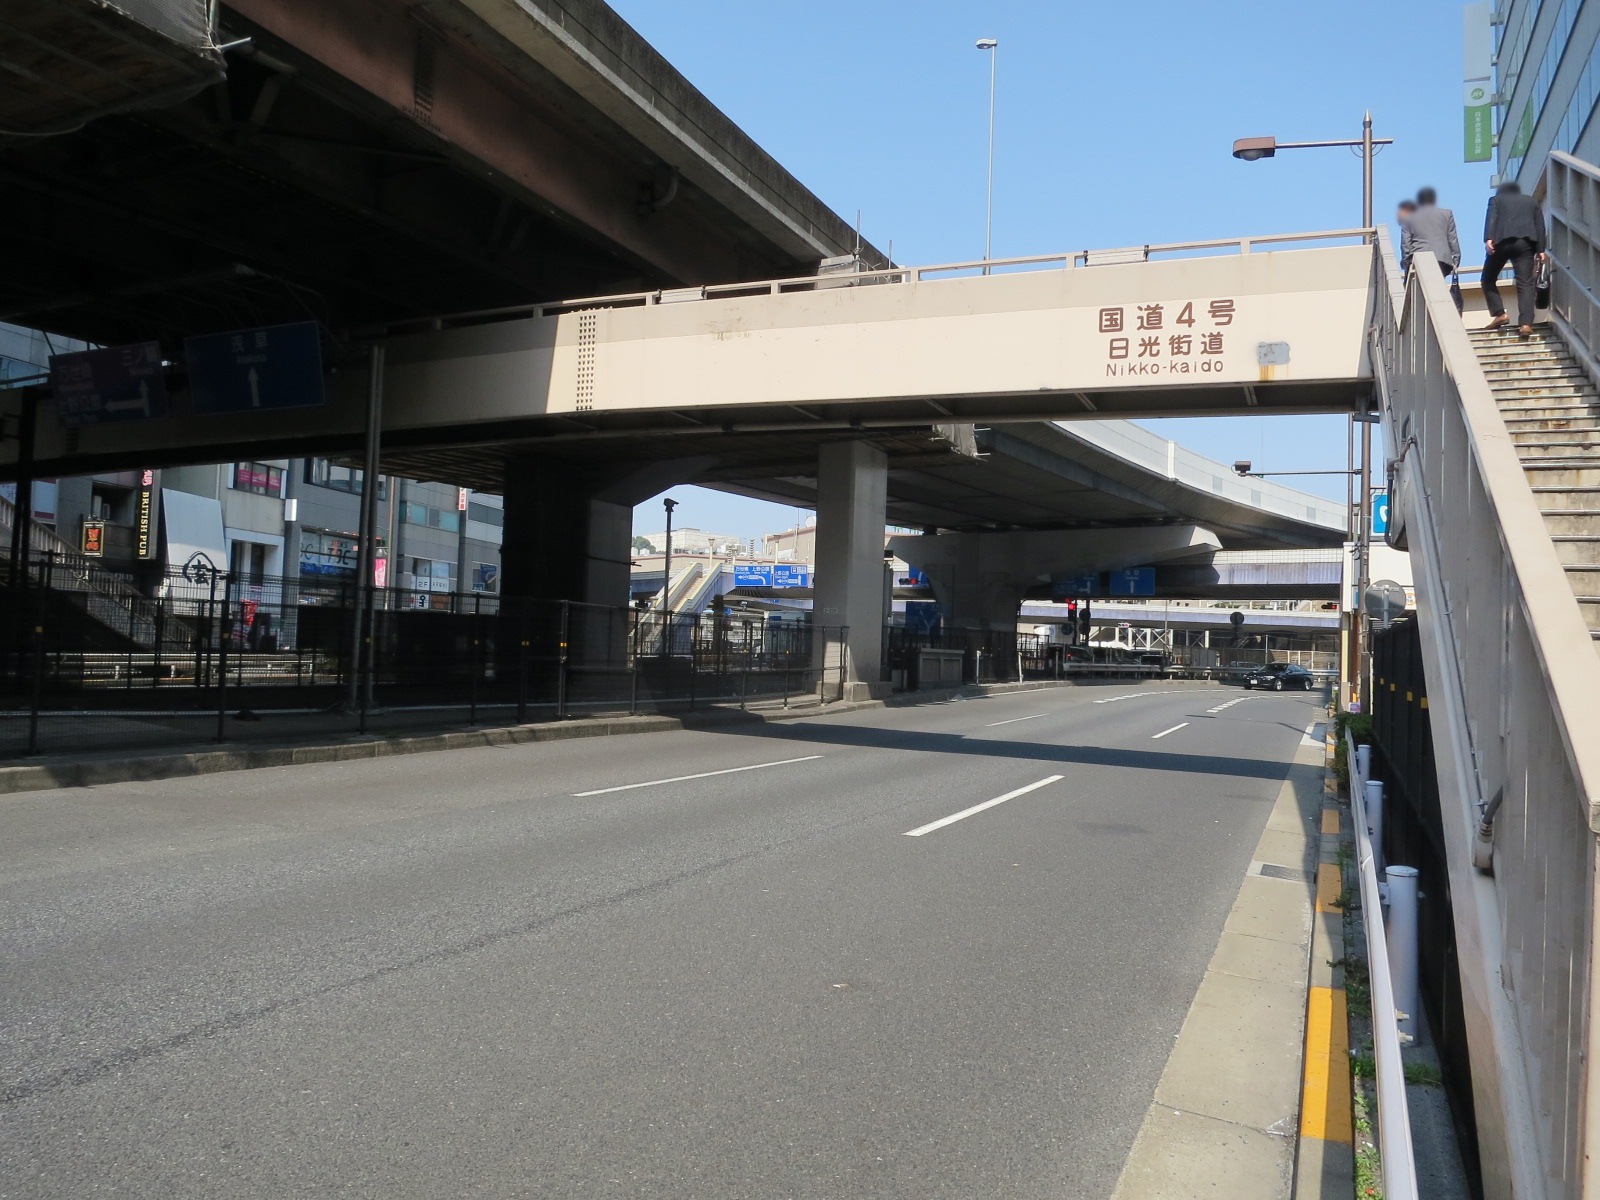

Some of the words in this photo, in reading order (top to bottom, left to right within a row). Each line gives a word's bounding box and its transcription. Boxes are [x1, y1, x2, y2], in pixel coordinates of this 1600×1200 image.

[1098, 299, 1236, 334] 国道4号
[1109, 331, 1224, 360] 日光街道
[1105, 359, 1224, 377] Nikko-kaido
[140, 491, 150, 533] BRITISH
[138, 535, 148, 556] PUB
